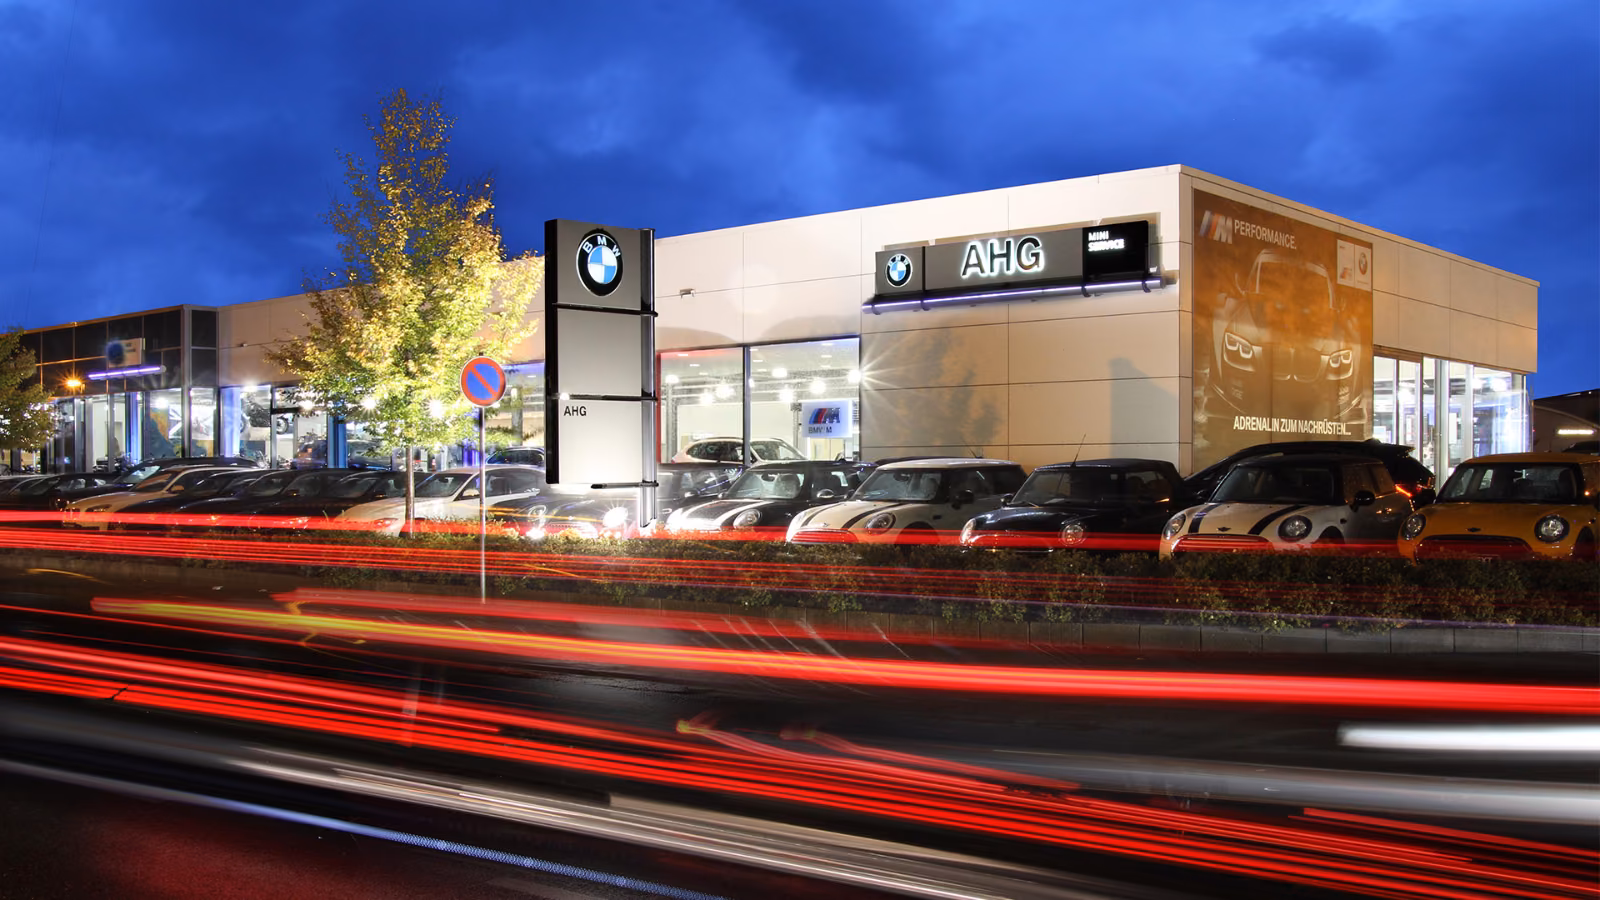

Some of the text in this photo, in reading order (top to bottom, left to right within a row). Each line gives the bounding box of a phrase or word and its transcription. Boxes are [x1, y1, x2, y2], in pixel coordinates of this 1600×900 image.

[1088, 230, 1109, 241] MINI
[1234, 219, 1297, 250] PERFORMANCE.
[582, 235, 621, 257] BMW
[961, 236, 1044, 278] AHG
[563, 405, 587, 417] AHG
[1233, 415, 1280, 432] ADRENALIN
[1280, 418, 1297, 433] ZUM
